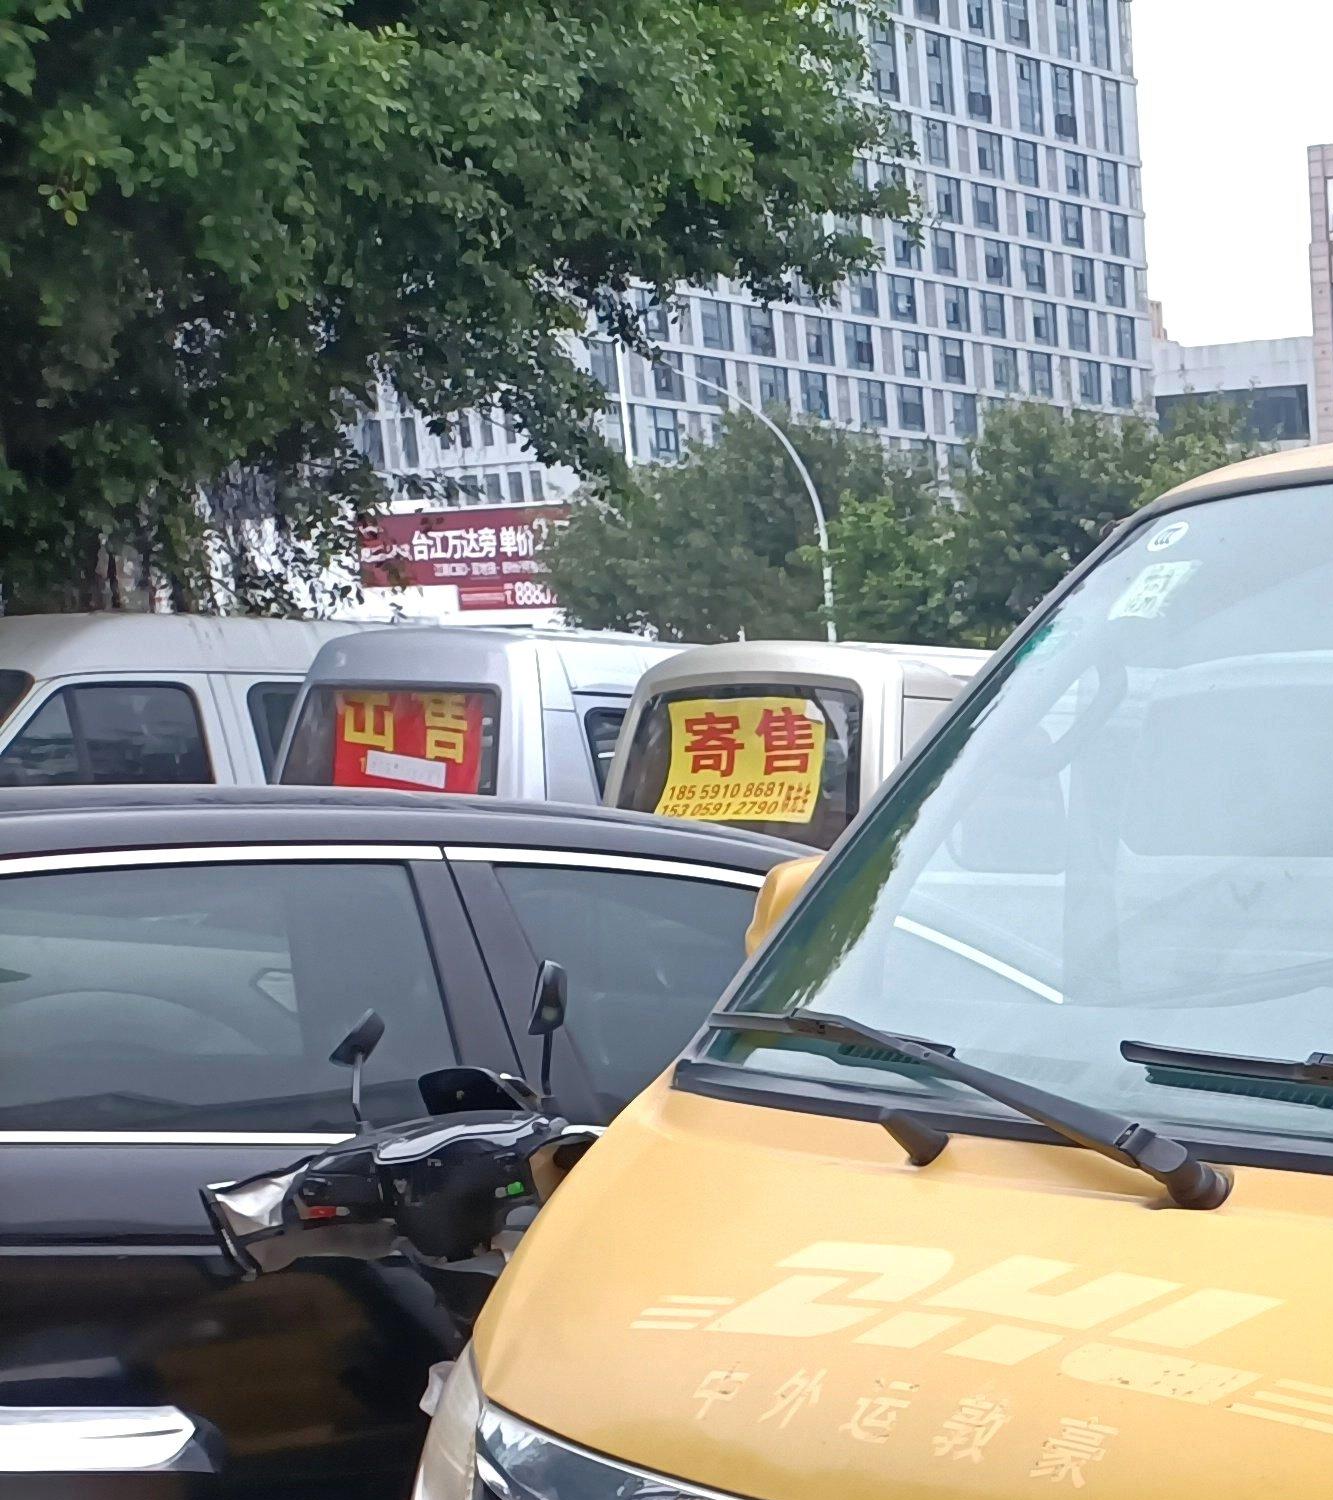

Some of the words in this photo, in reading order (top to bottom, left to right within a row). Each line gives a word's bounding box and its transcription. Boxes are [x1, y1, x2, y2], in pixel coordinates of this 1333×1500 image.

[344, 691, 468, 764] 出售
[684, 707, 815, 778] 寄售
[662, 804, 690, 817] 153
[690, 802, 732, 817] 0591
[733, 800, 779, 815] 2790
[669, 785, 696, 801] 185
[700, 783, 741, 800] 5910
[743, 781, 785, 799] 8681
[703, 1240, 1287, 1406] DHL
